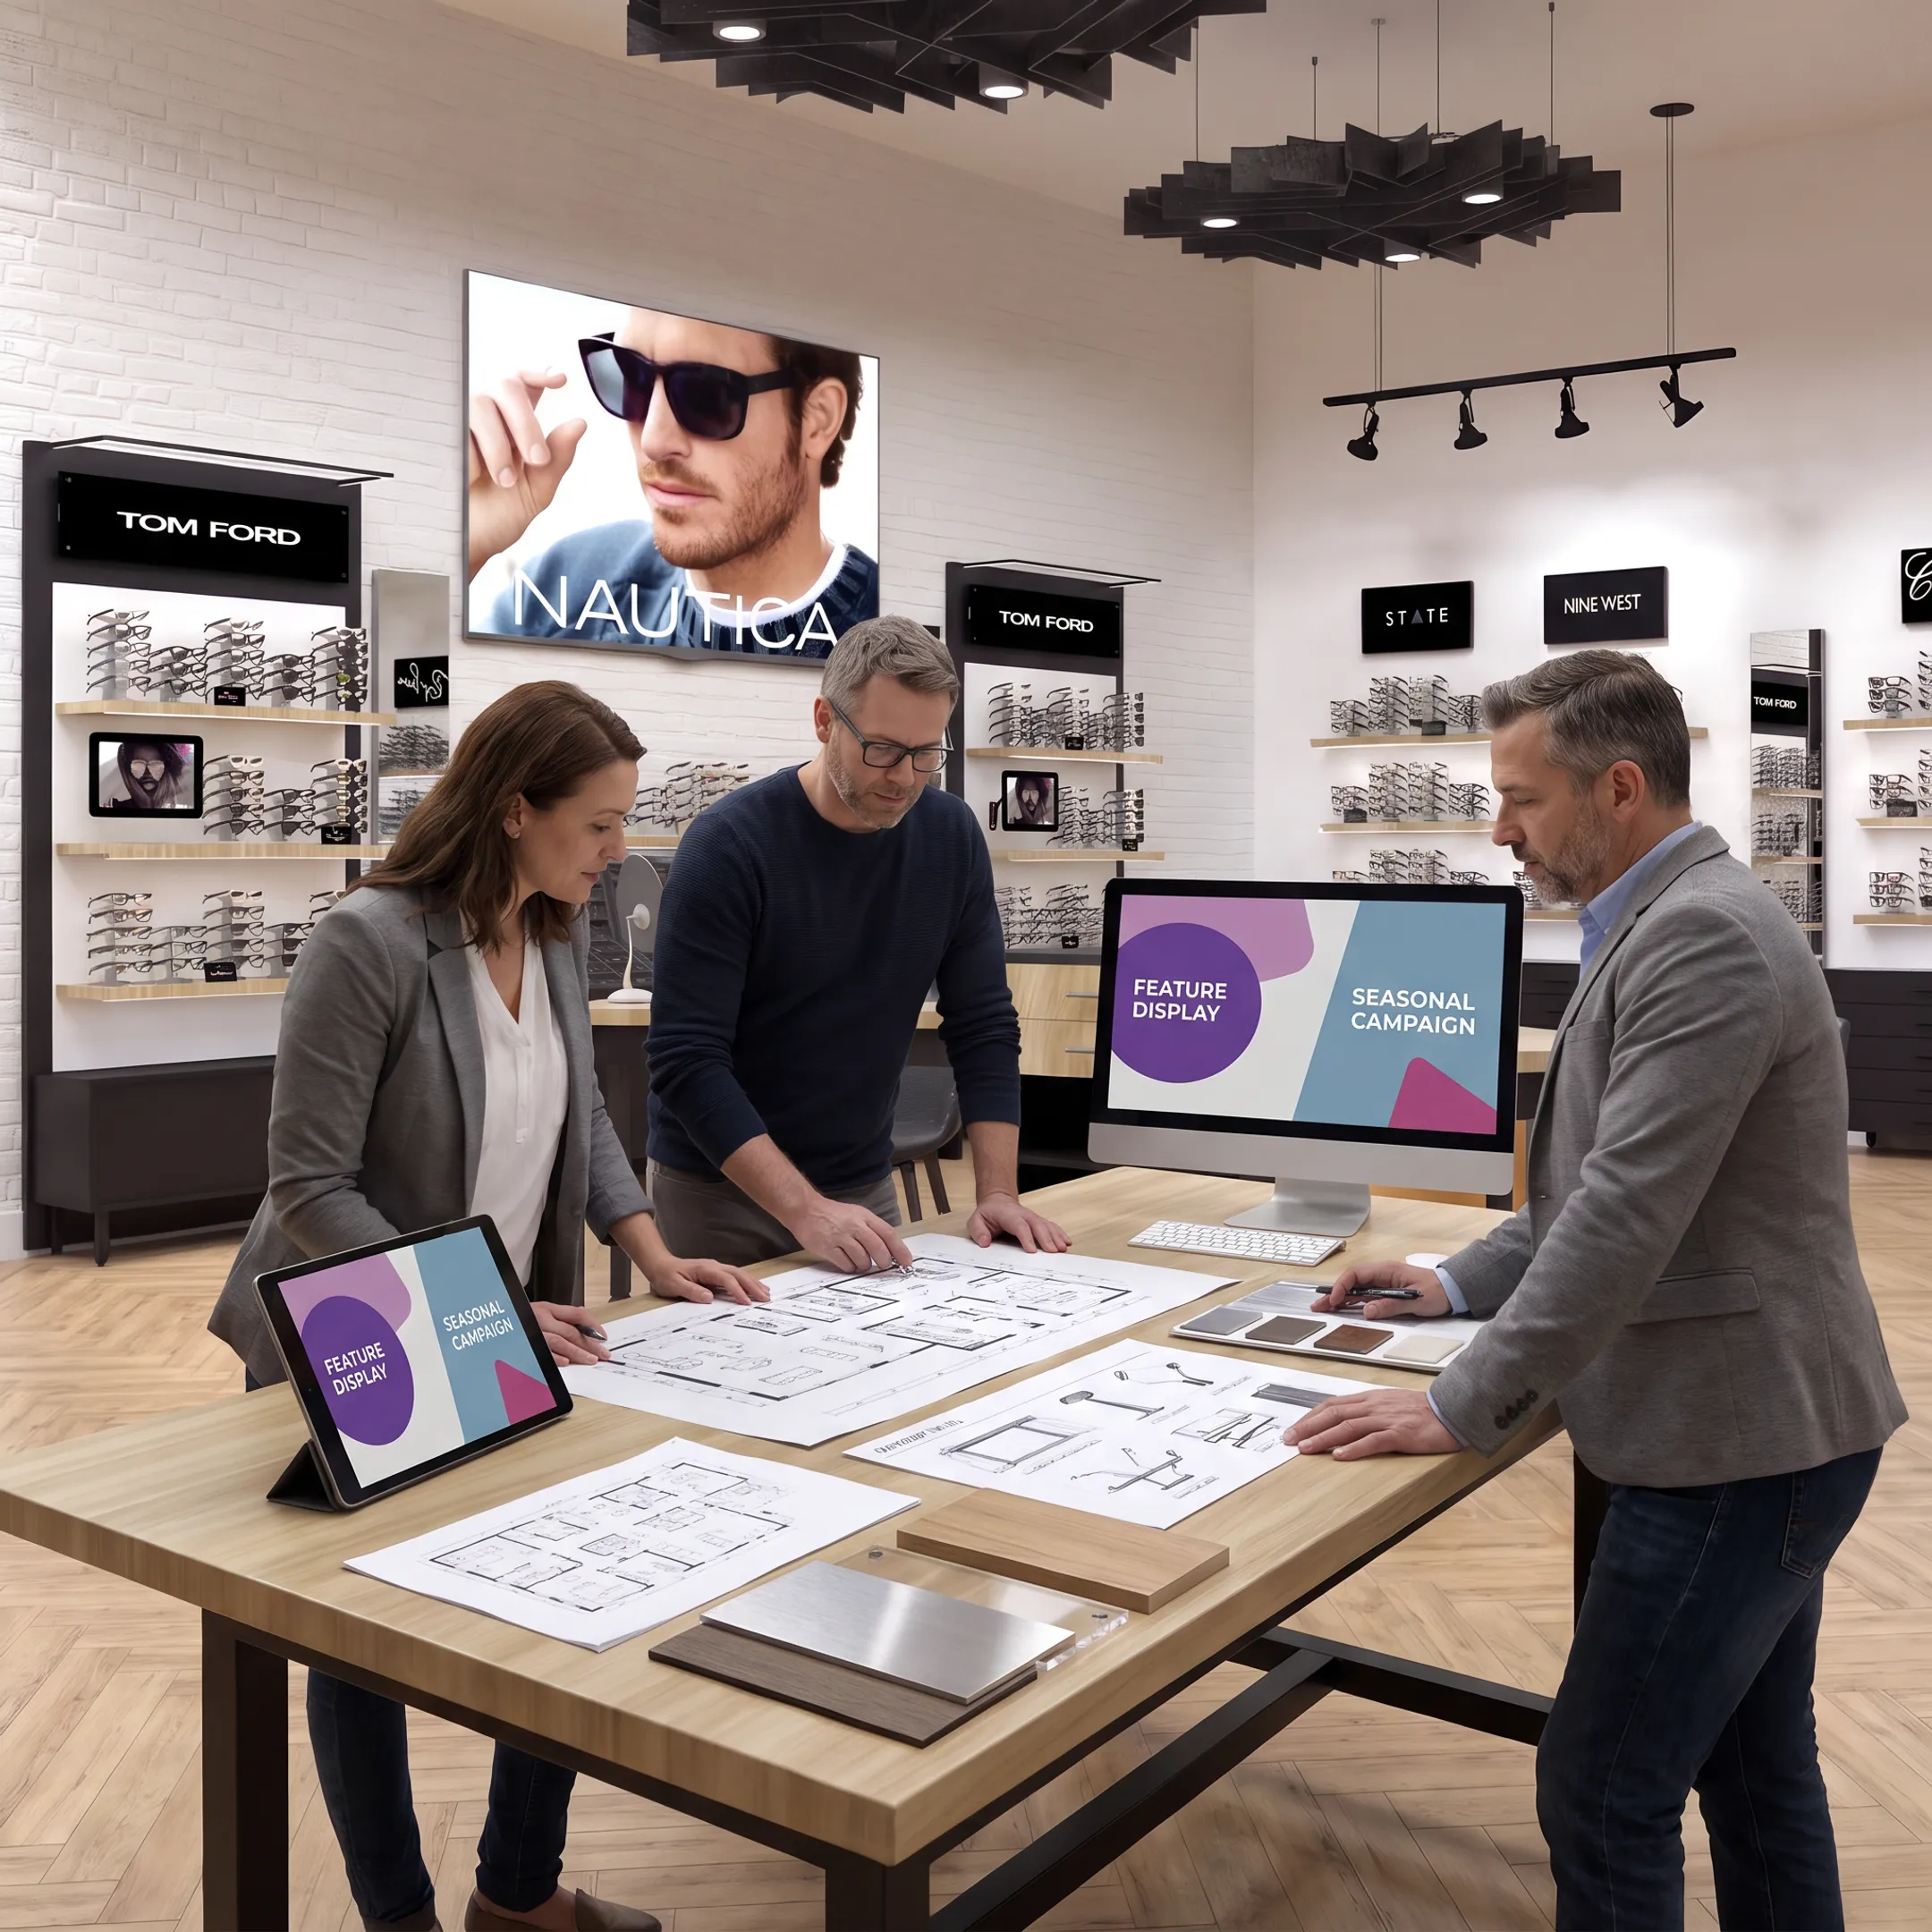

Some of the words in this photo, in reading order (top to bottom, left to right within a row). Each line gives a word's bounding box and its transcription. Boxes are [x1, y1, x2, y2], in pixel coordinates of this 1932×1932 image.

[116, 511, 198, 536] TOM
[209, 521, 301, 546] FORD
[513, 569, 837, 650] NAUTICA
[1563, 596, 1598, 614] NINE
[1600, 593, 1641, 612] WEST
[998, 610, 1040, 627] TOM
[1046, 615, 1094, 632] FORD
[1753, 696, 1774, 707] TOM
[1775, 699, 1797, 709] FORD
[1133, 979, 1227, 1000] FEATURE
[1352, 987, 1475, 1011] SEASONAL
[1132, 1002, 1220, 1021] DISPLAY
[1351, 1012, 1475, 1035] CAMPAIGN
[443, 1300, 505, 1332] SEASONAL
[452, 1317, 514, 1351] CAMPAIGN
[324, 1342, 386, 1375] FEATURE
[333, 1362, 387, 1395] DISPLAY
